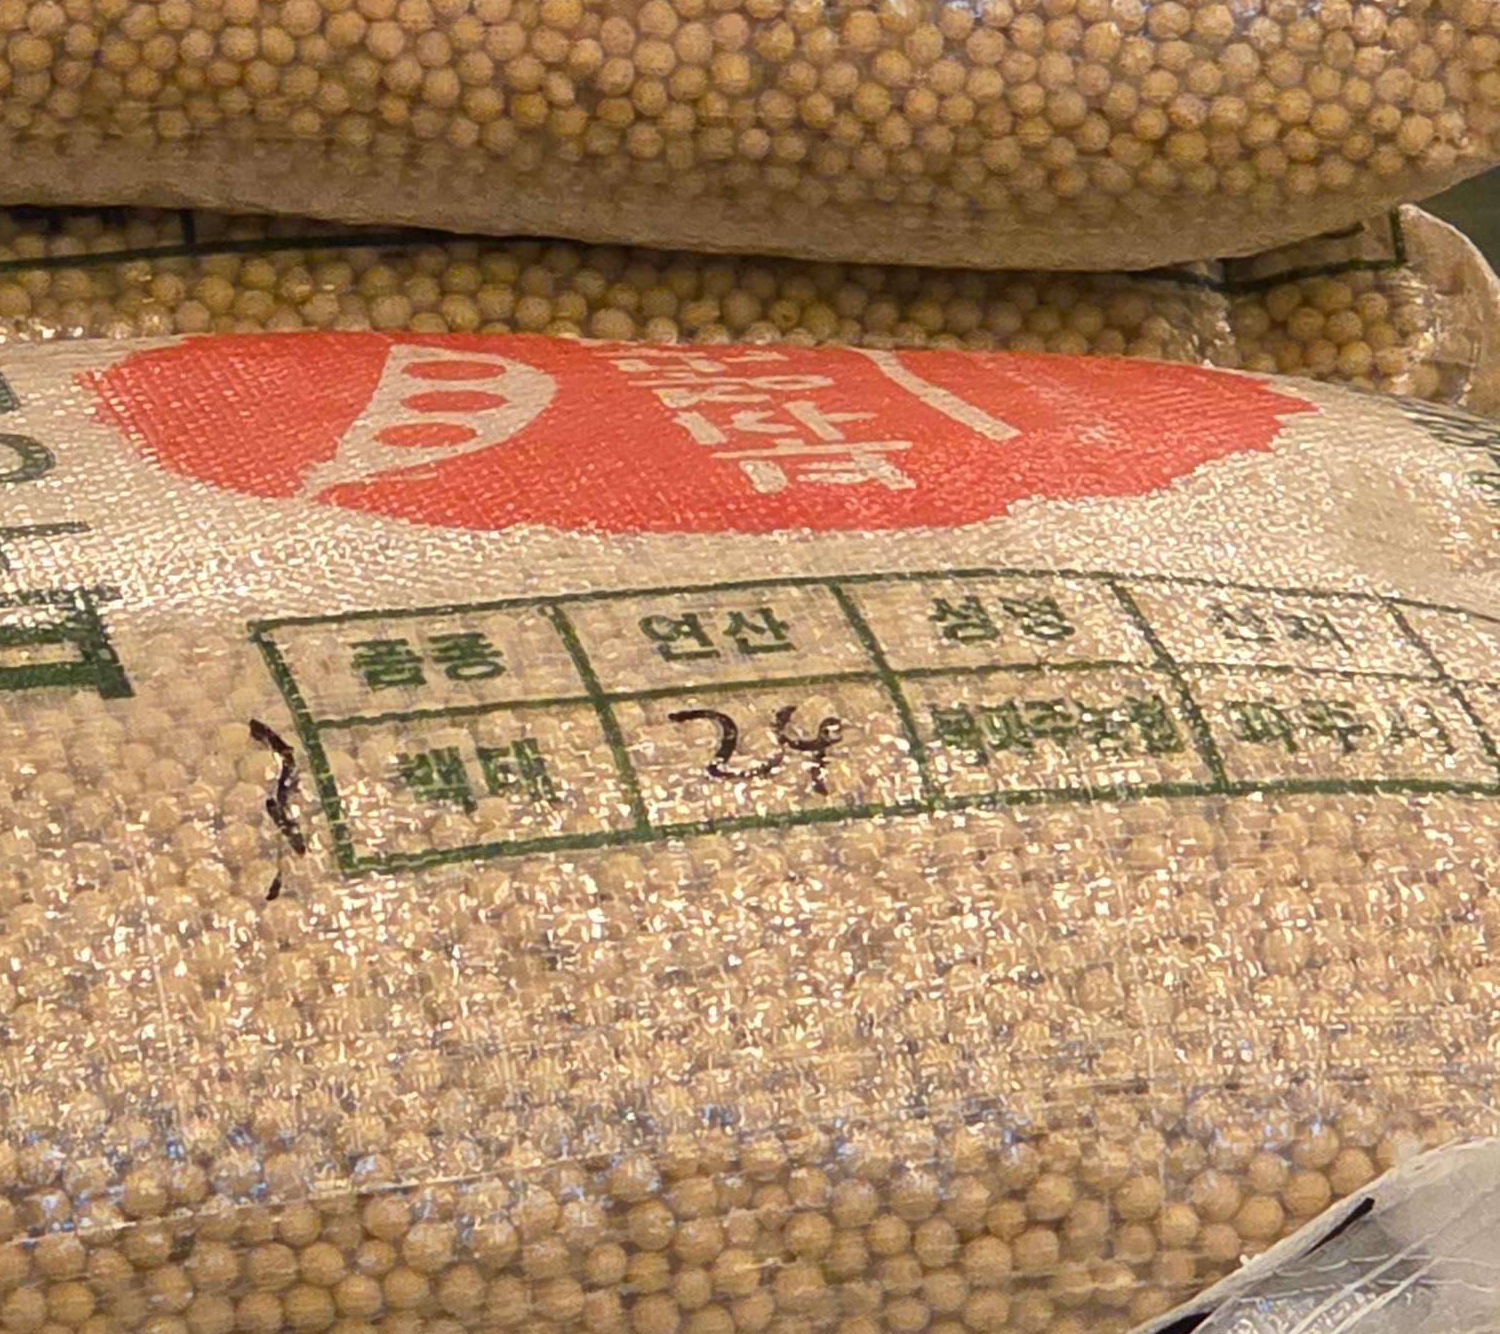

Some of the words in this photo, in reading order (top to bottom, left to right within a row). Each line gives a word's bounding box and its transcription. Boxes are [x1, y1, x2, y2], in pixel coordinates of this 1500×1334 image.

[350, 631, 505, 691] 품종
[638, 607, 797, 663] 연산
[666, 704, 852, 797] 24
